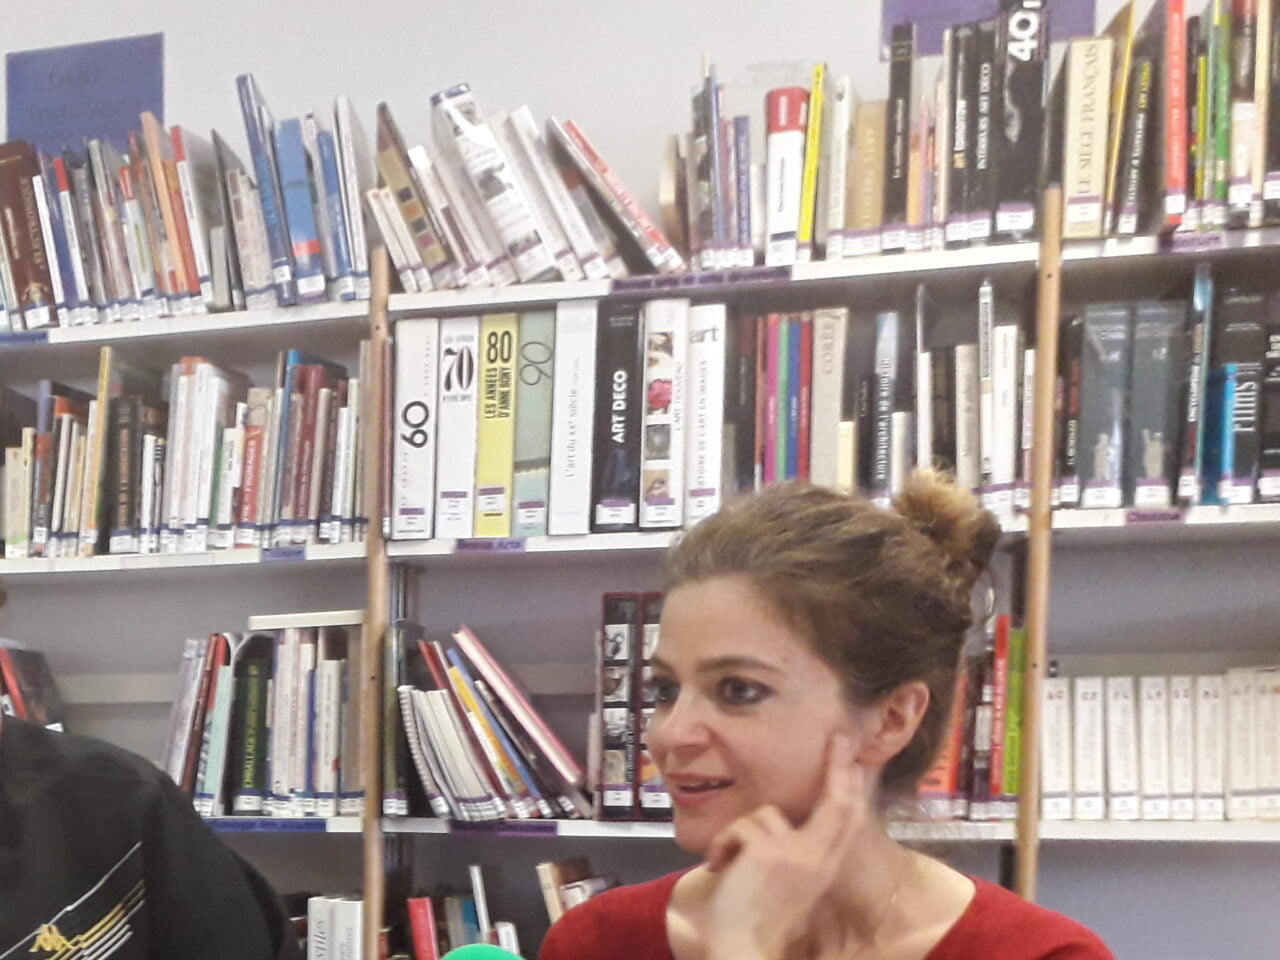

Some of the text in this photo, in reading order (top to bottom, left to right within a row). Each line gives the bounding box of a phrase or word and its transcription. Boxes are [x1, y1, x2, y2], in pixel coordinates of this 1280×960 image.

[443, 346, 474, 392] 70
[487, 330, 512, 364] 80
[519, 340, 553, 386] 90
[400, 400, 430, 448] 60
[485, 403, 496, 419] LES
[612, 370, 629, 443] ART DECO
[879, 401, 889, 412] de
[876, 415, 889, 480] l'architecture
